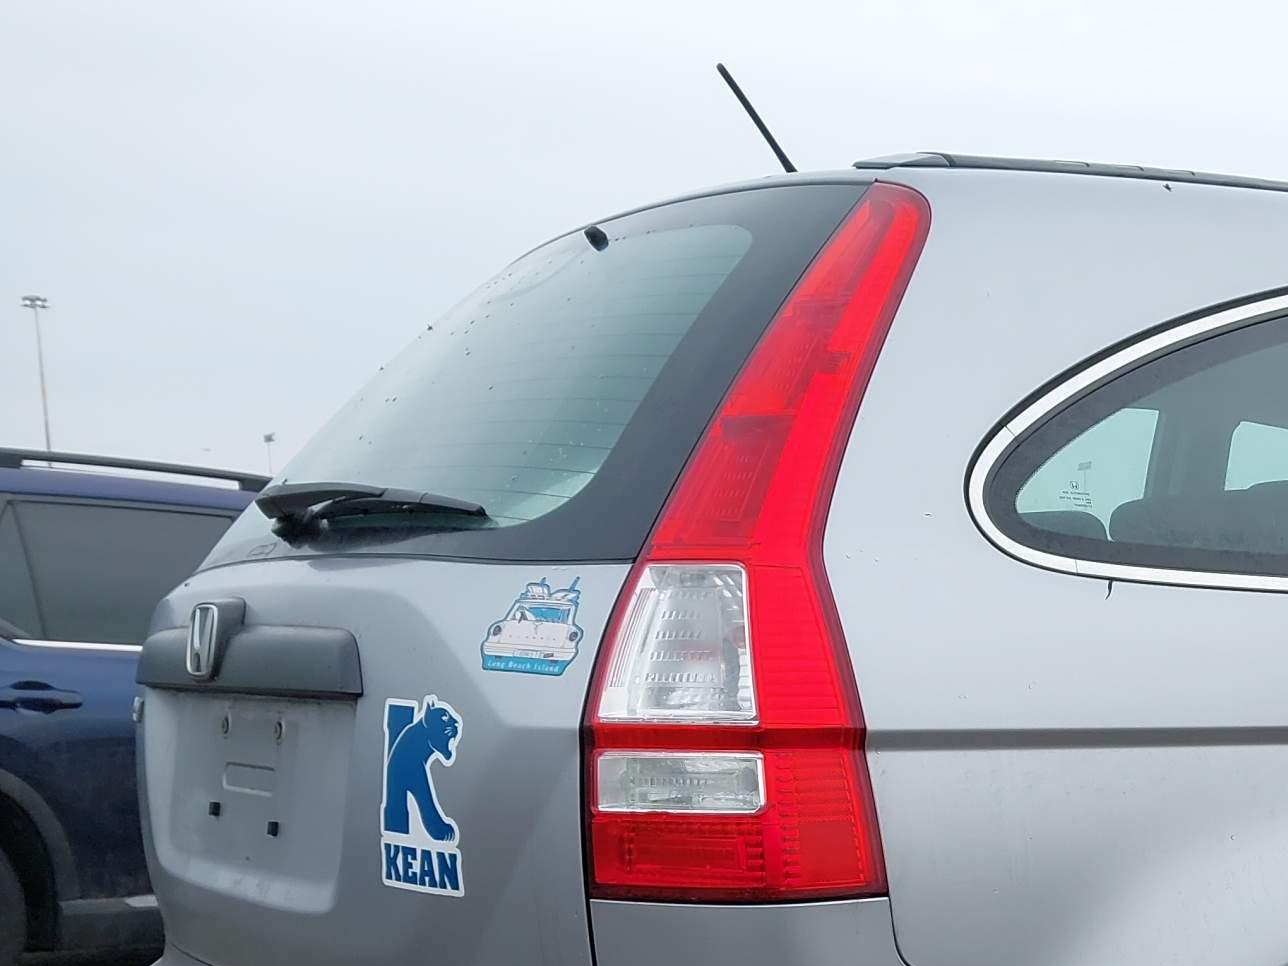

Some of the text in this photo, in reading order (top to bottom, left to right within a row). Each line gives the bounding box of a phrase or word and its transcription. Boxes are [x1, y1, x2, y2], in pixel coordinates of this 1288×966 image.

[507, 661, 531, 671] Beach
[534, 663, 560, 673] Island
[384, 842, 461, 891] KEAN
